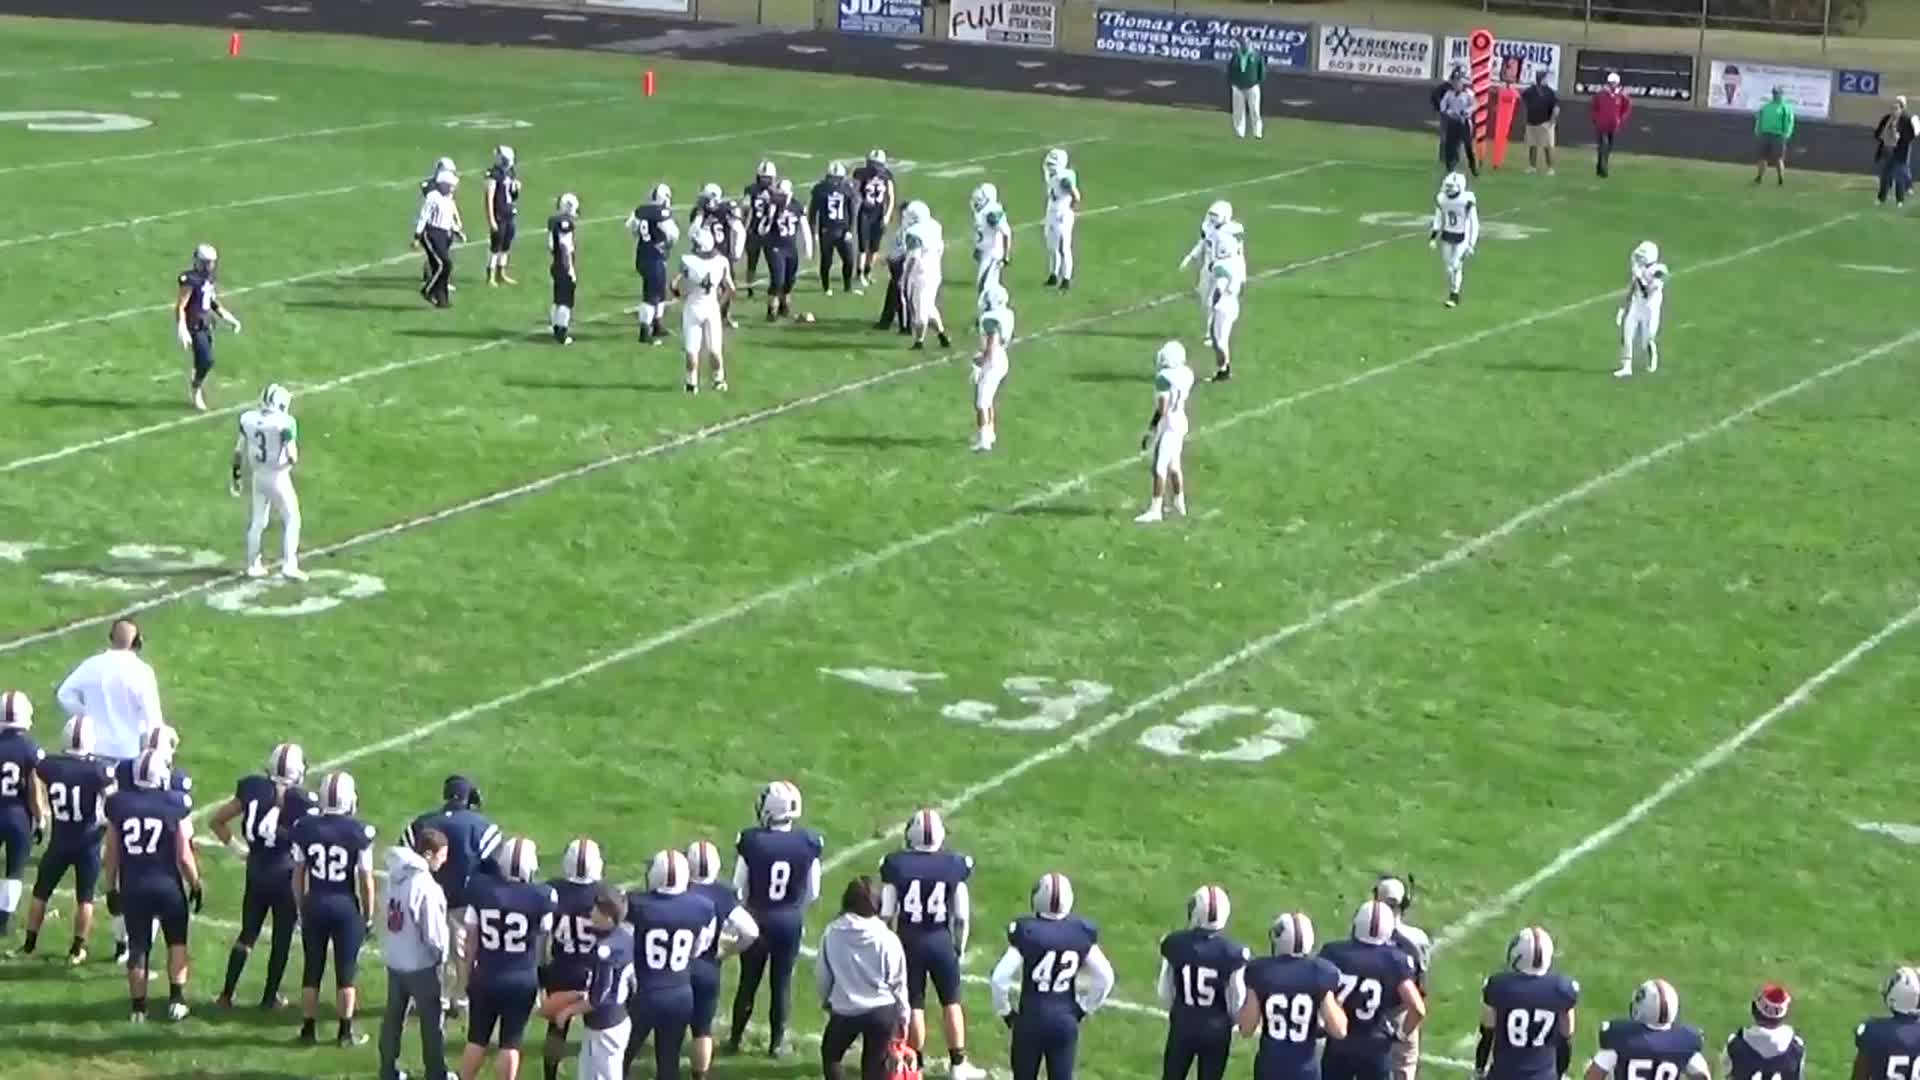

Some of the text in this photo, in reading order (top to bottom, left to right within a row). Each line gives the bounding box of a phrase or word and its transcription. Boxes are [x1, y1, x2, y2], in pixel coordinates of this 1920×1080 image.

[952, 3, 1003, 36] FUJI
[1099, 11, 1308, 46] Thomas C. Morrissey
[1112, 28, 1169, 44] CERTIFIED
[1171, 34, 1211, 47] PUBLIC
[1351, 48, 1424, 62] AUTOMOTIVE
[1843, 76, 1875, 92] 20
[777, 215, 798, 237] 55
[827, 196, 844, 220] 51
[700, 272, 713, 295] 4
[254, 431, 268, 463] 3
[50, 783, 82, 822] 21
[123, 818, 163, 855] 27
[246, 800, 281, 848] 14
[308, 844, 349, 883] 32
[769, 861, 791, 900] 8
[903, 879, 947, 923] 44
[480, 909, 529, 953] 52
[555, 914, 597, 954] 45
[645, 928, 694, 972] 68
[1031, 949, 1080, 992] 42
[1181, 963, 1219, 1007] 15
[1336, 974, 1382, 1021] 73
[1265, 993, 1313, 1043] 69
[1506, 1008, 1555, 1047] 87
